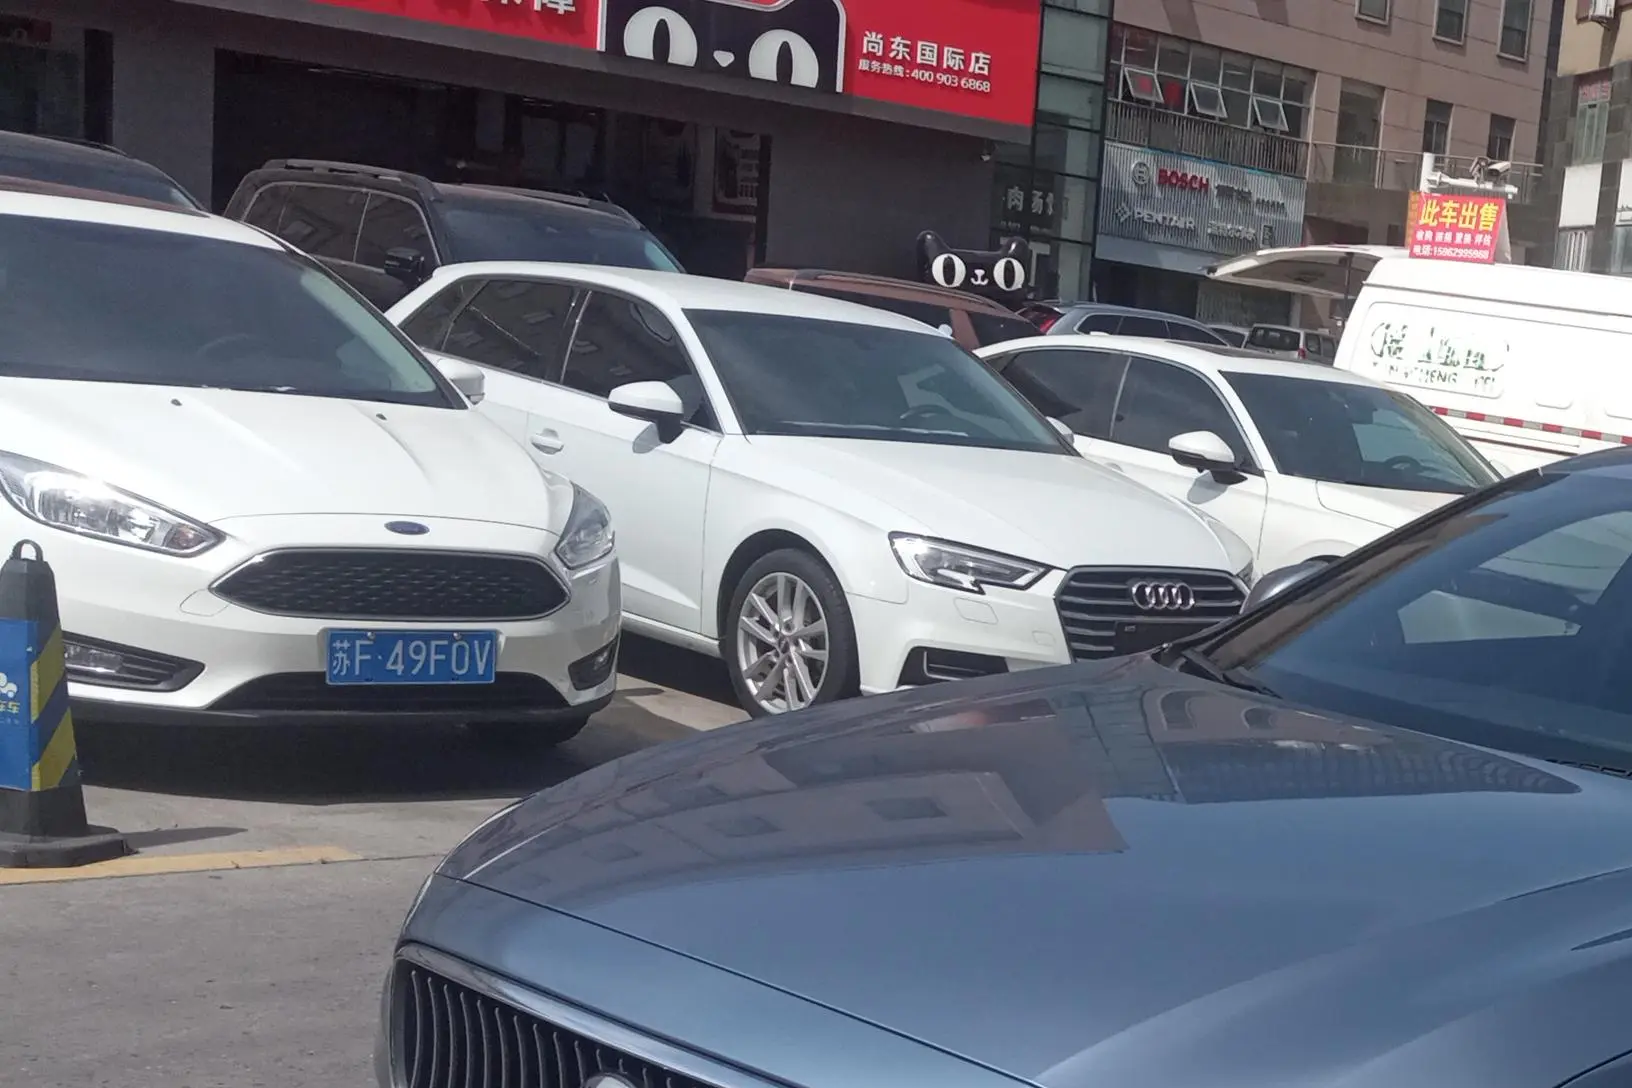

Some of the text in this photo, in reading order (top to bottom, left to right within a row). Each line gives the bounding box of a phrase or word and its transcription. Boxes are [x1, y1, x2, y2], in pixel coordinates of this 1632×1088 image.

[862, 30, 992, 76] 尚东国际店
[1158, 168, 1210, 193] BOSCH
[1419, 199, 1500, 232] 此车出售
